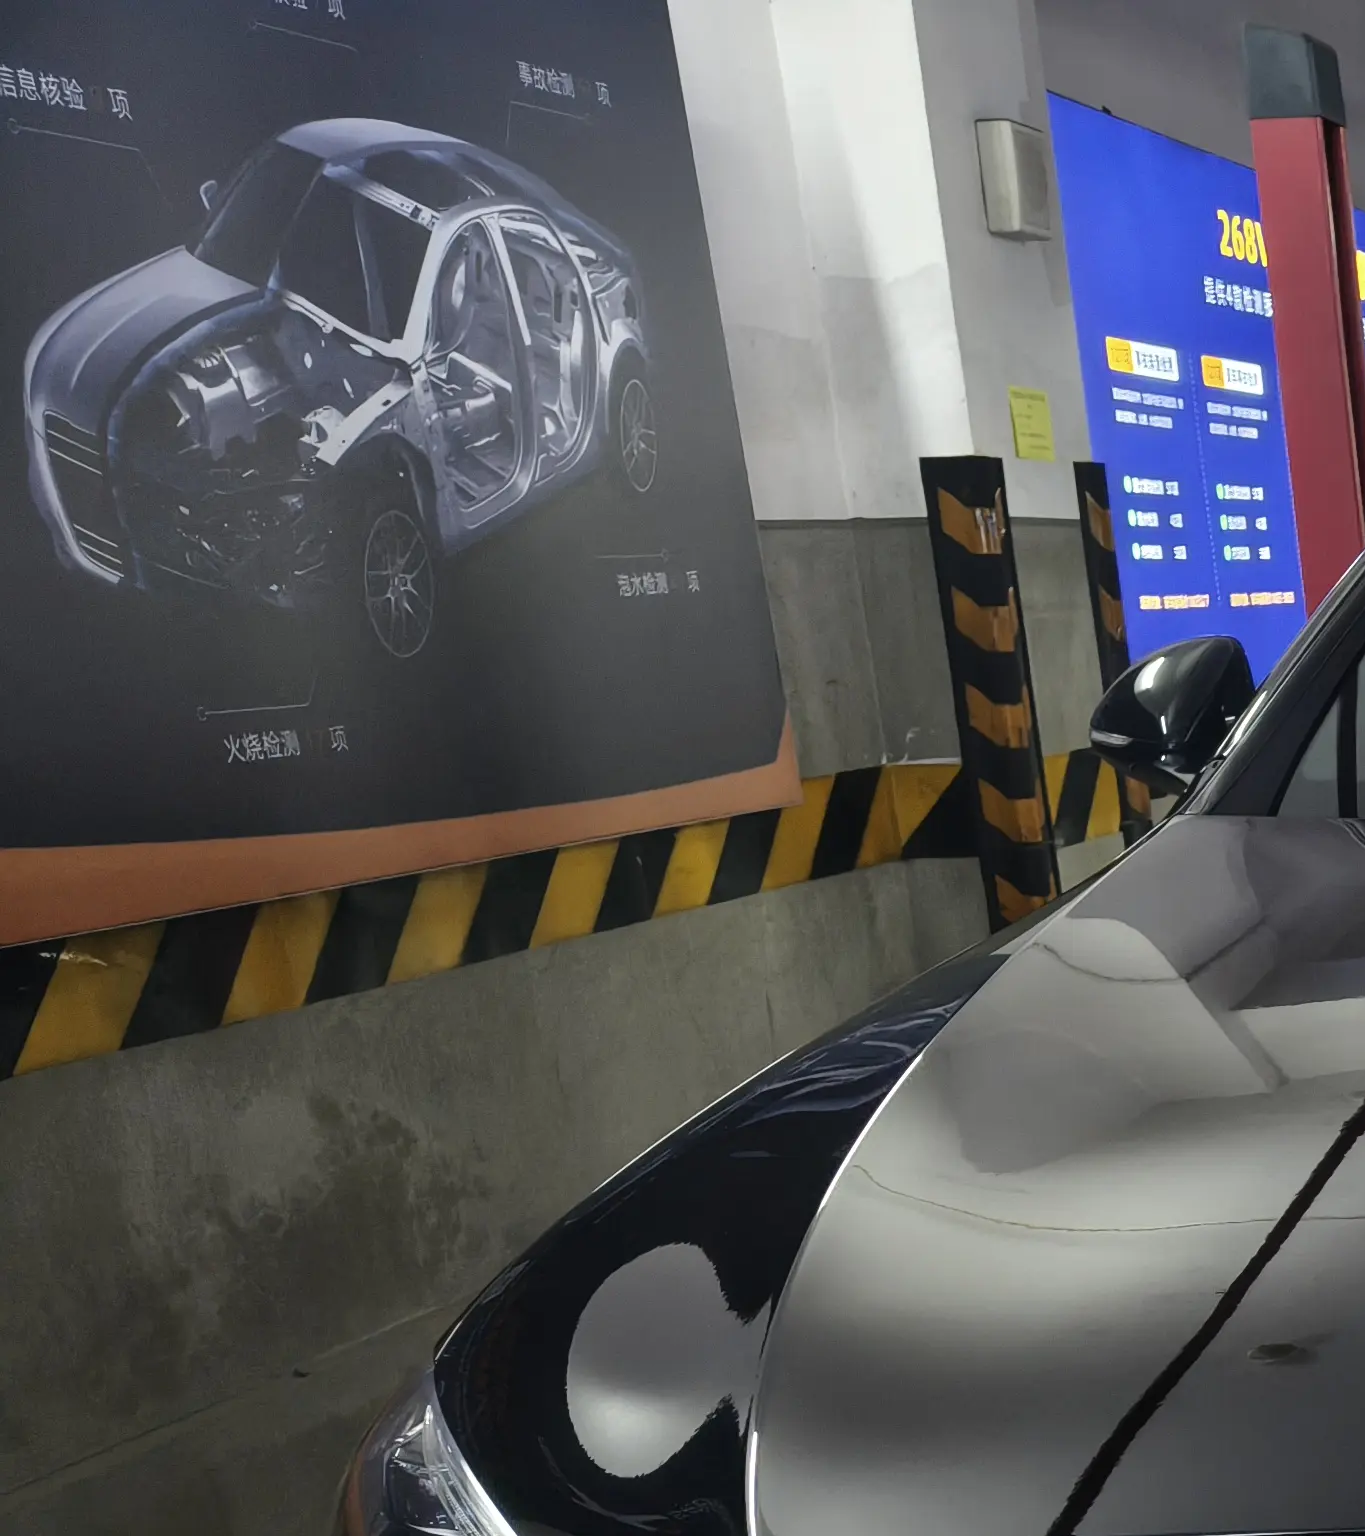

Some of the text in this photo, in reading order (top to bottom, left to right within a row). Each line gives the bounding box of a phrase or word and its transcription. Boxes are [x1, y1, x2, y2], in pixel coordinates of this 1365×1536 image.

[0, 64, 134, 121] 信息核验 项
[223, 725, 349, 763] 火烧检测 项
